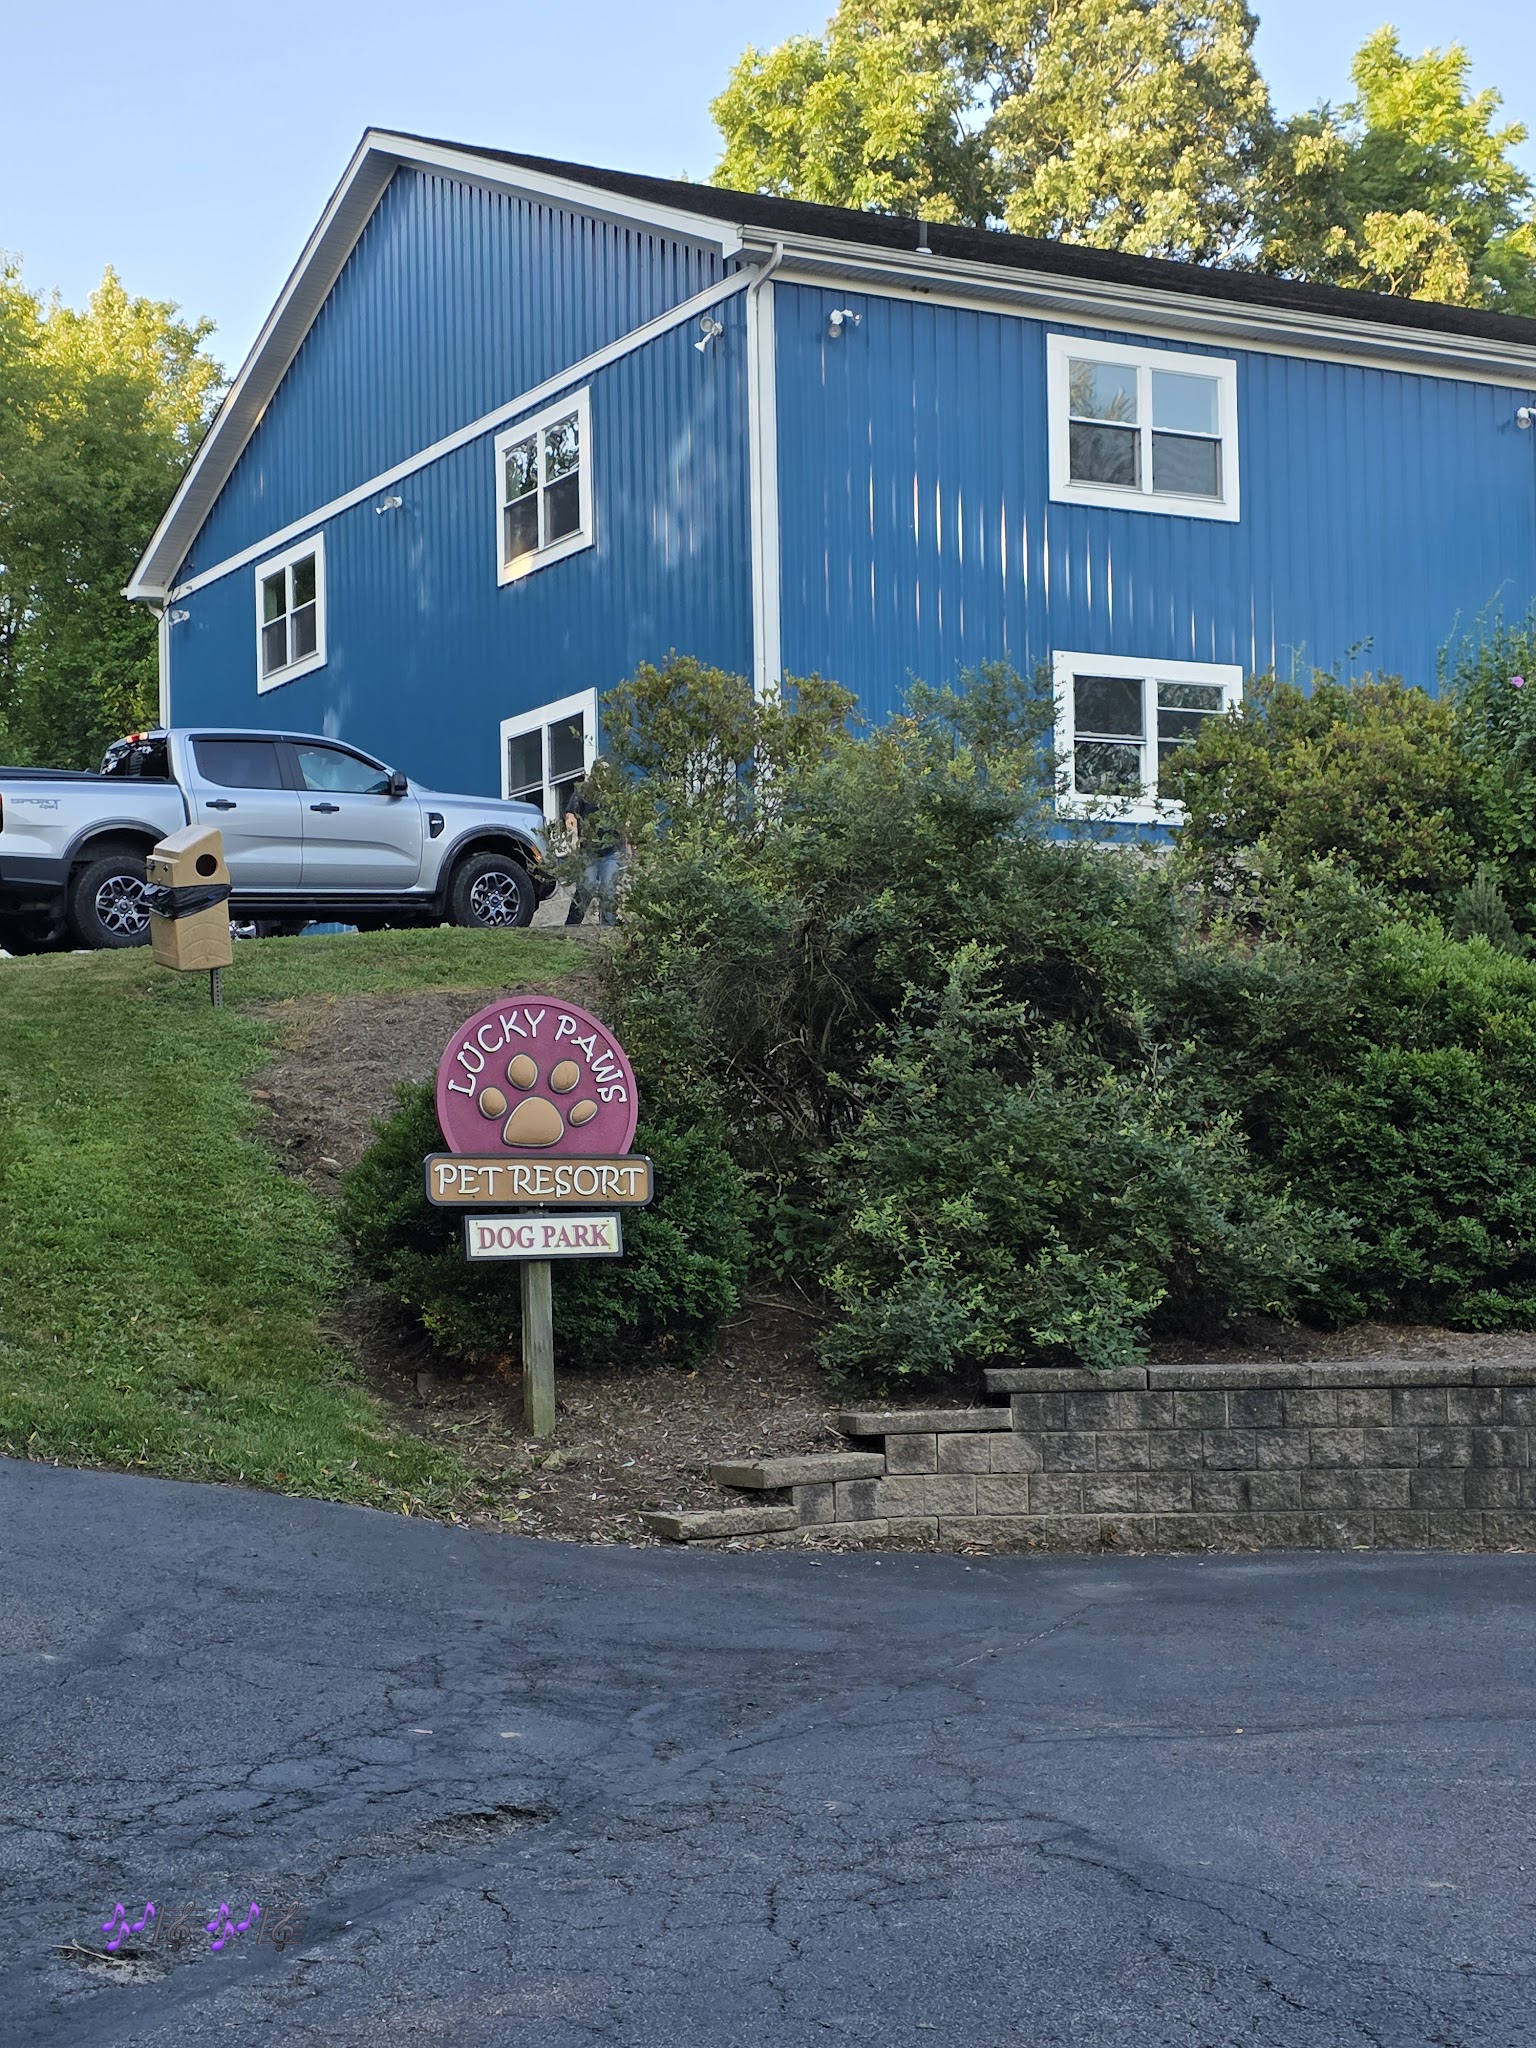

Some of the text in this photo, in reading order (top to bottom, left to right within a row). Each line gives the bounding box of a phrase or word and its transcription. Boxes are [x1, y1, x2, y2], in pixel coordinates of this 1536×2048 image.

[448, 1008, 627, 1104] LUCKY PAWS
[434, 1163, 645, 1198] PET RESORT
[477, 1223, 610, 1250] DOG PARK
